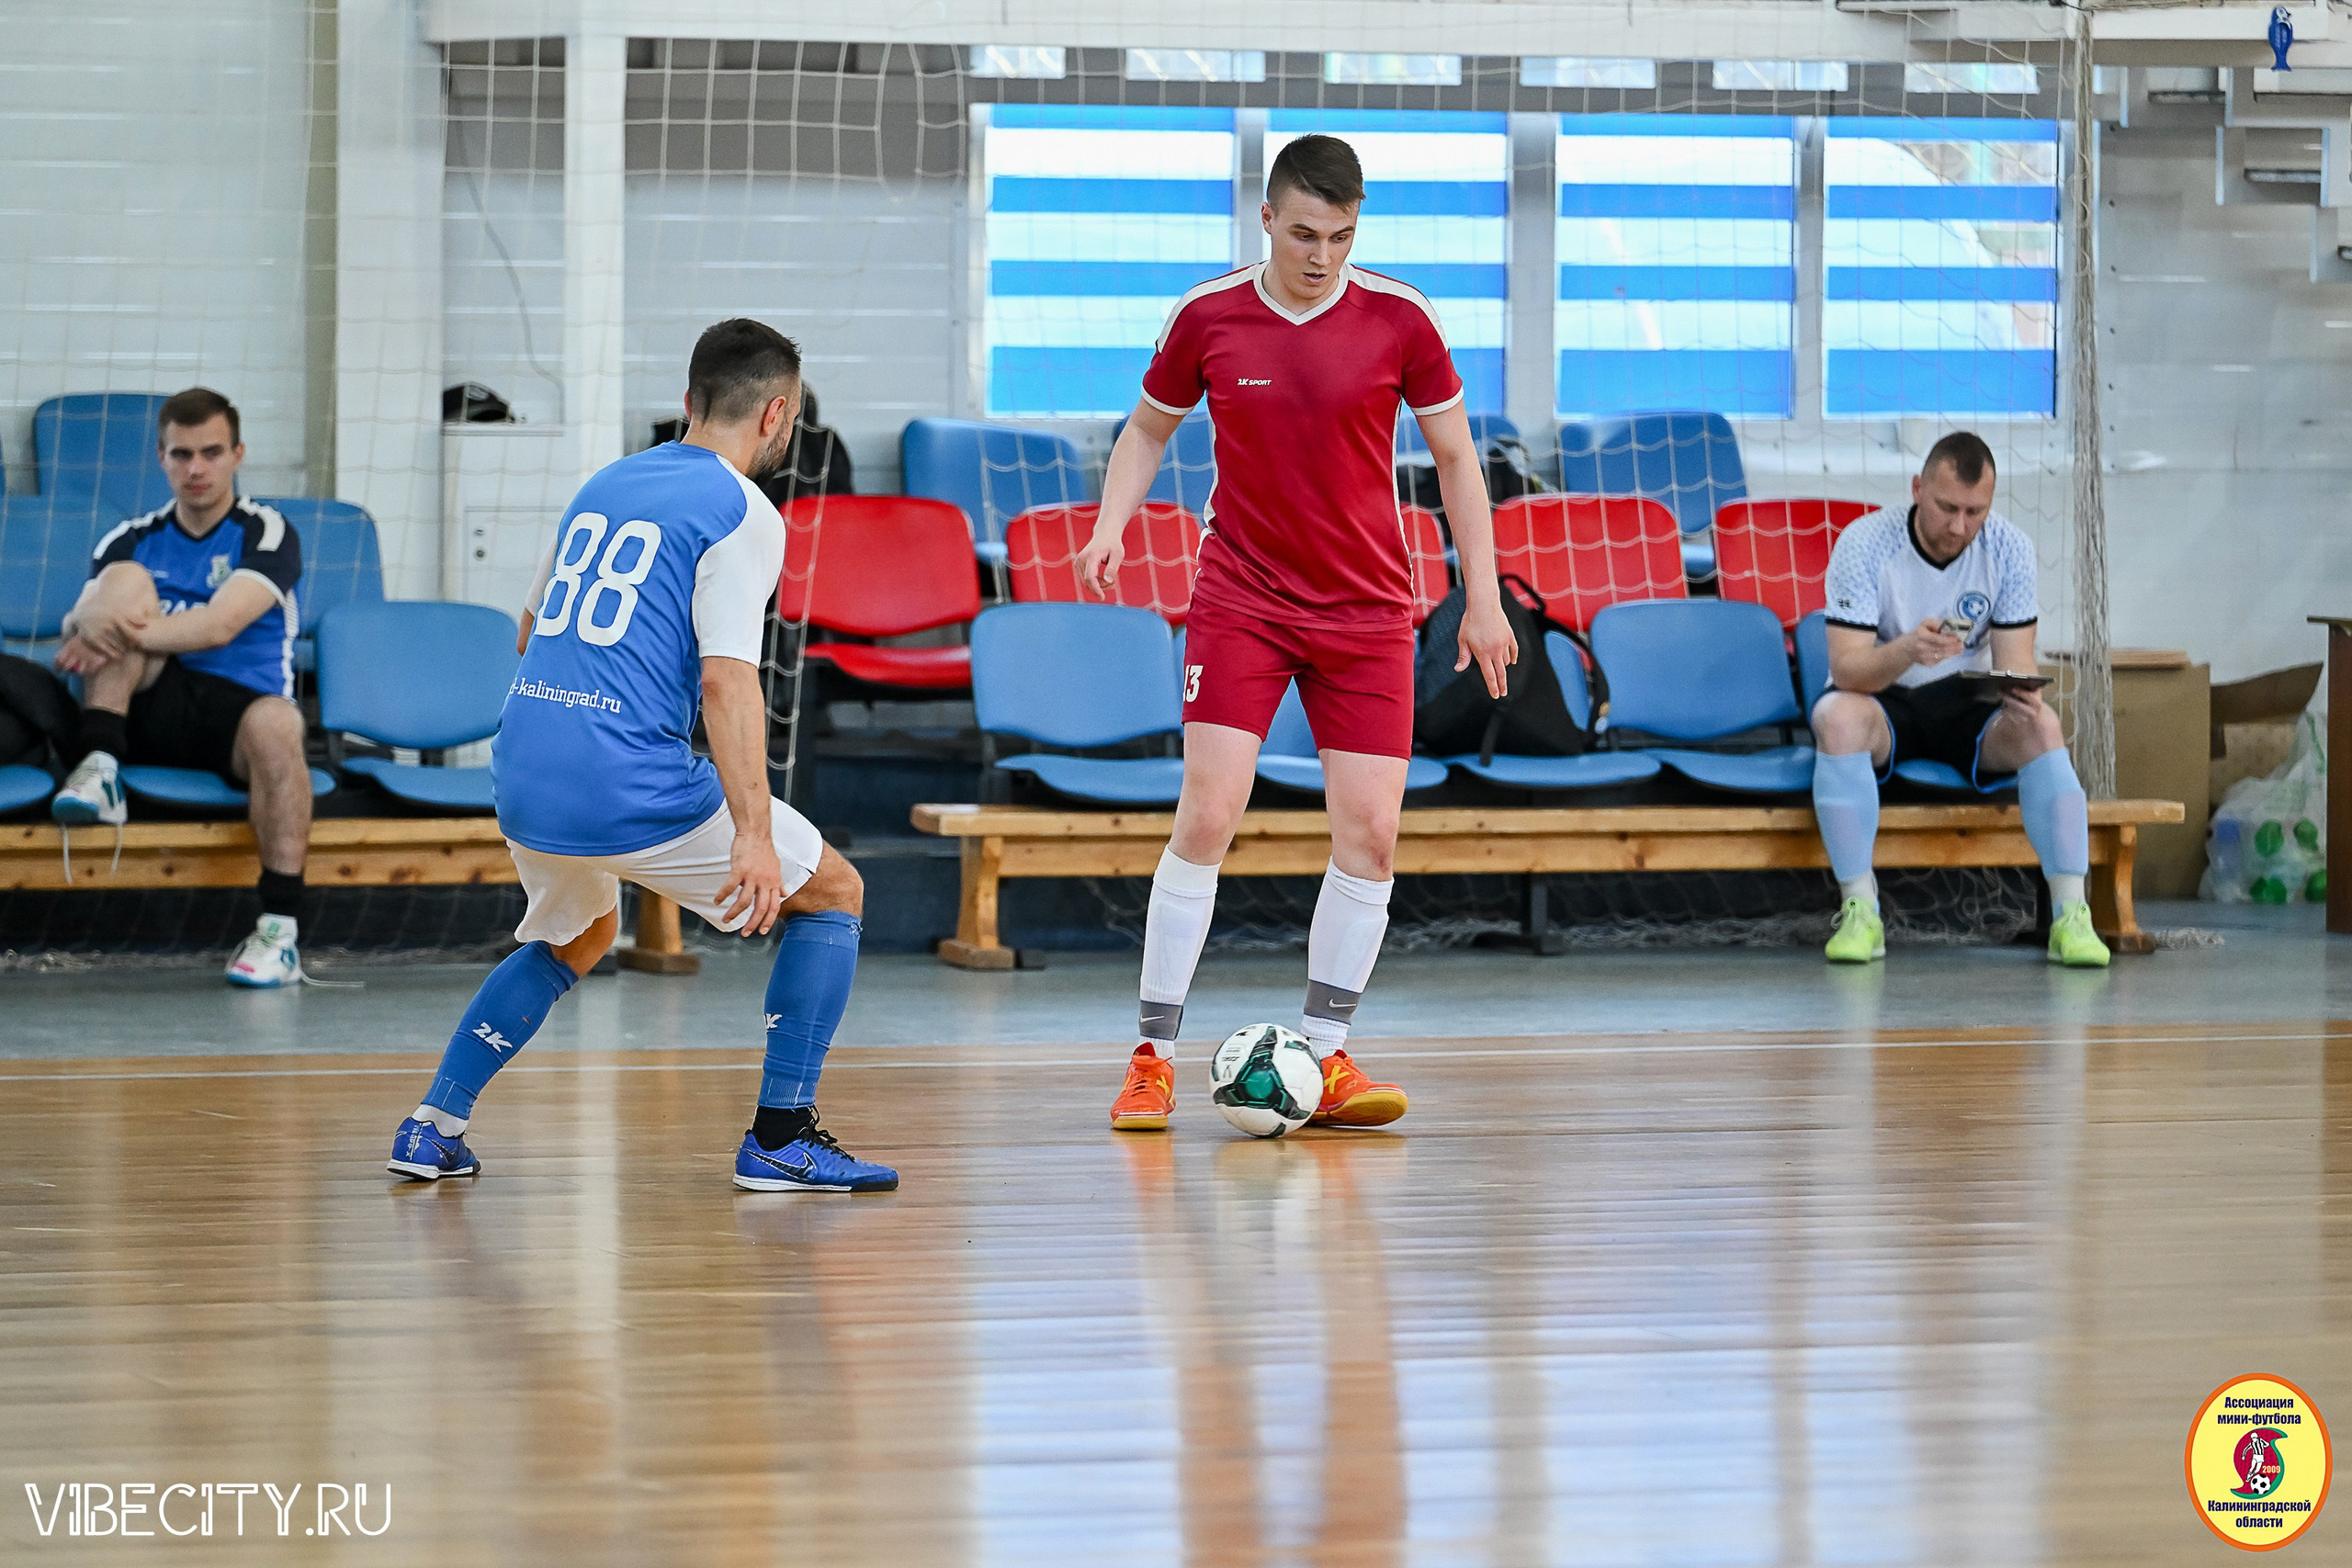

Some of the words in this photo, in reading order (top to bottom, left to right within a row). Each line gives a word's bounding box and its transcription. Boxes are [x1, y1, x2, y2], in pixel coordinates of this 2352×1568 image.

[1238, 378, 1250, 386] 2K
[534, 512, 662, 647] 88
[472, 1021, 513, 1053] 2K
